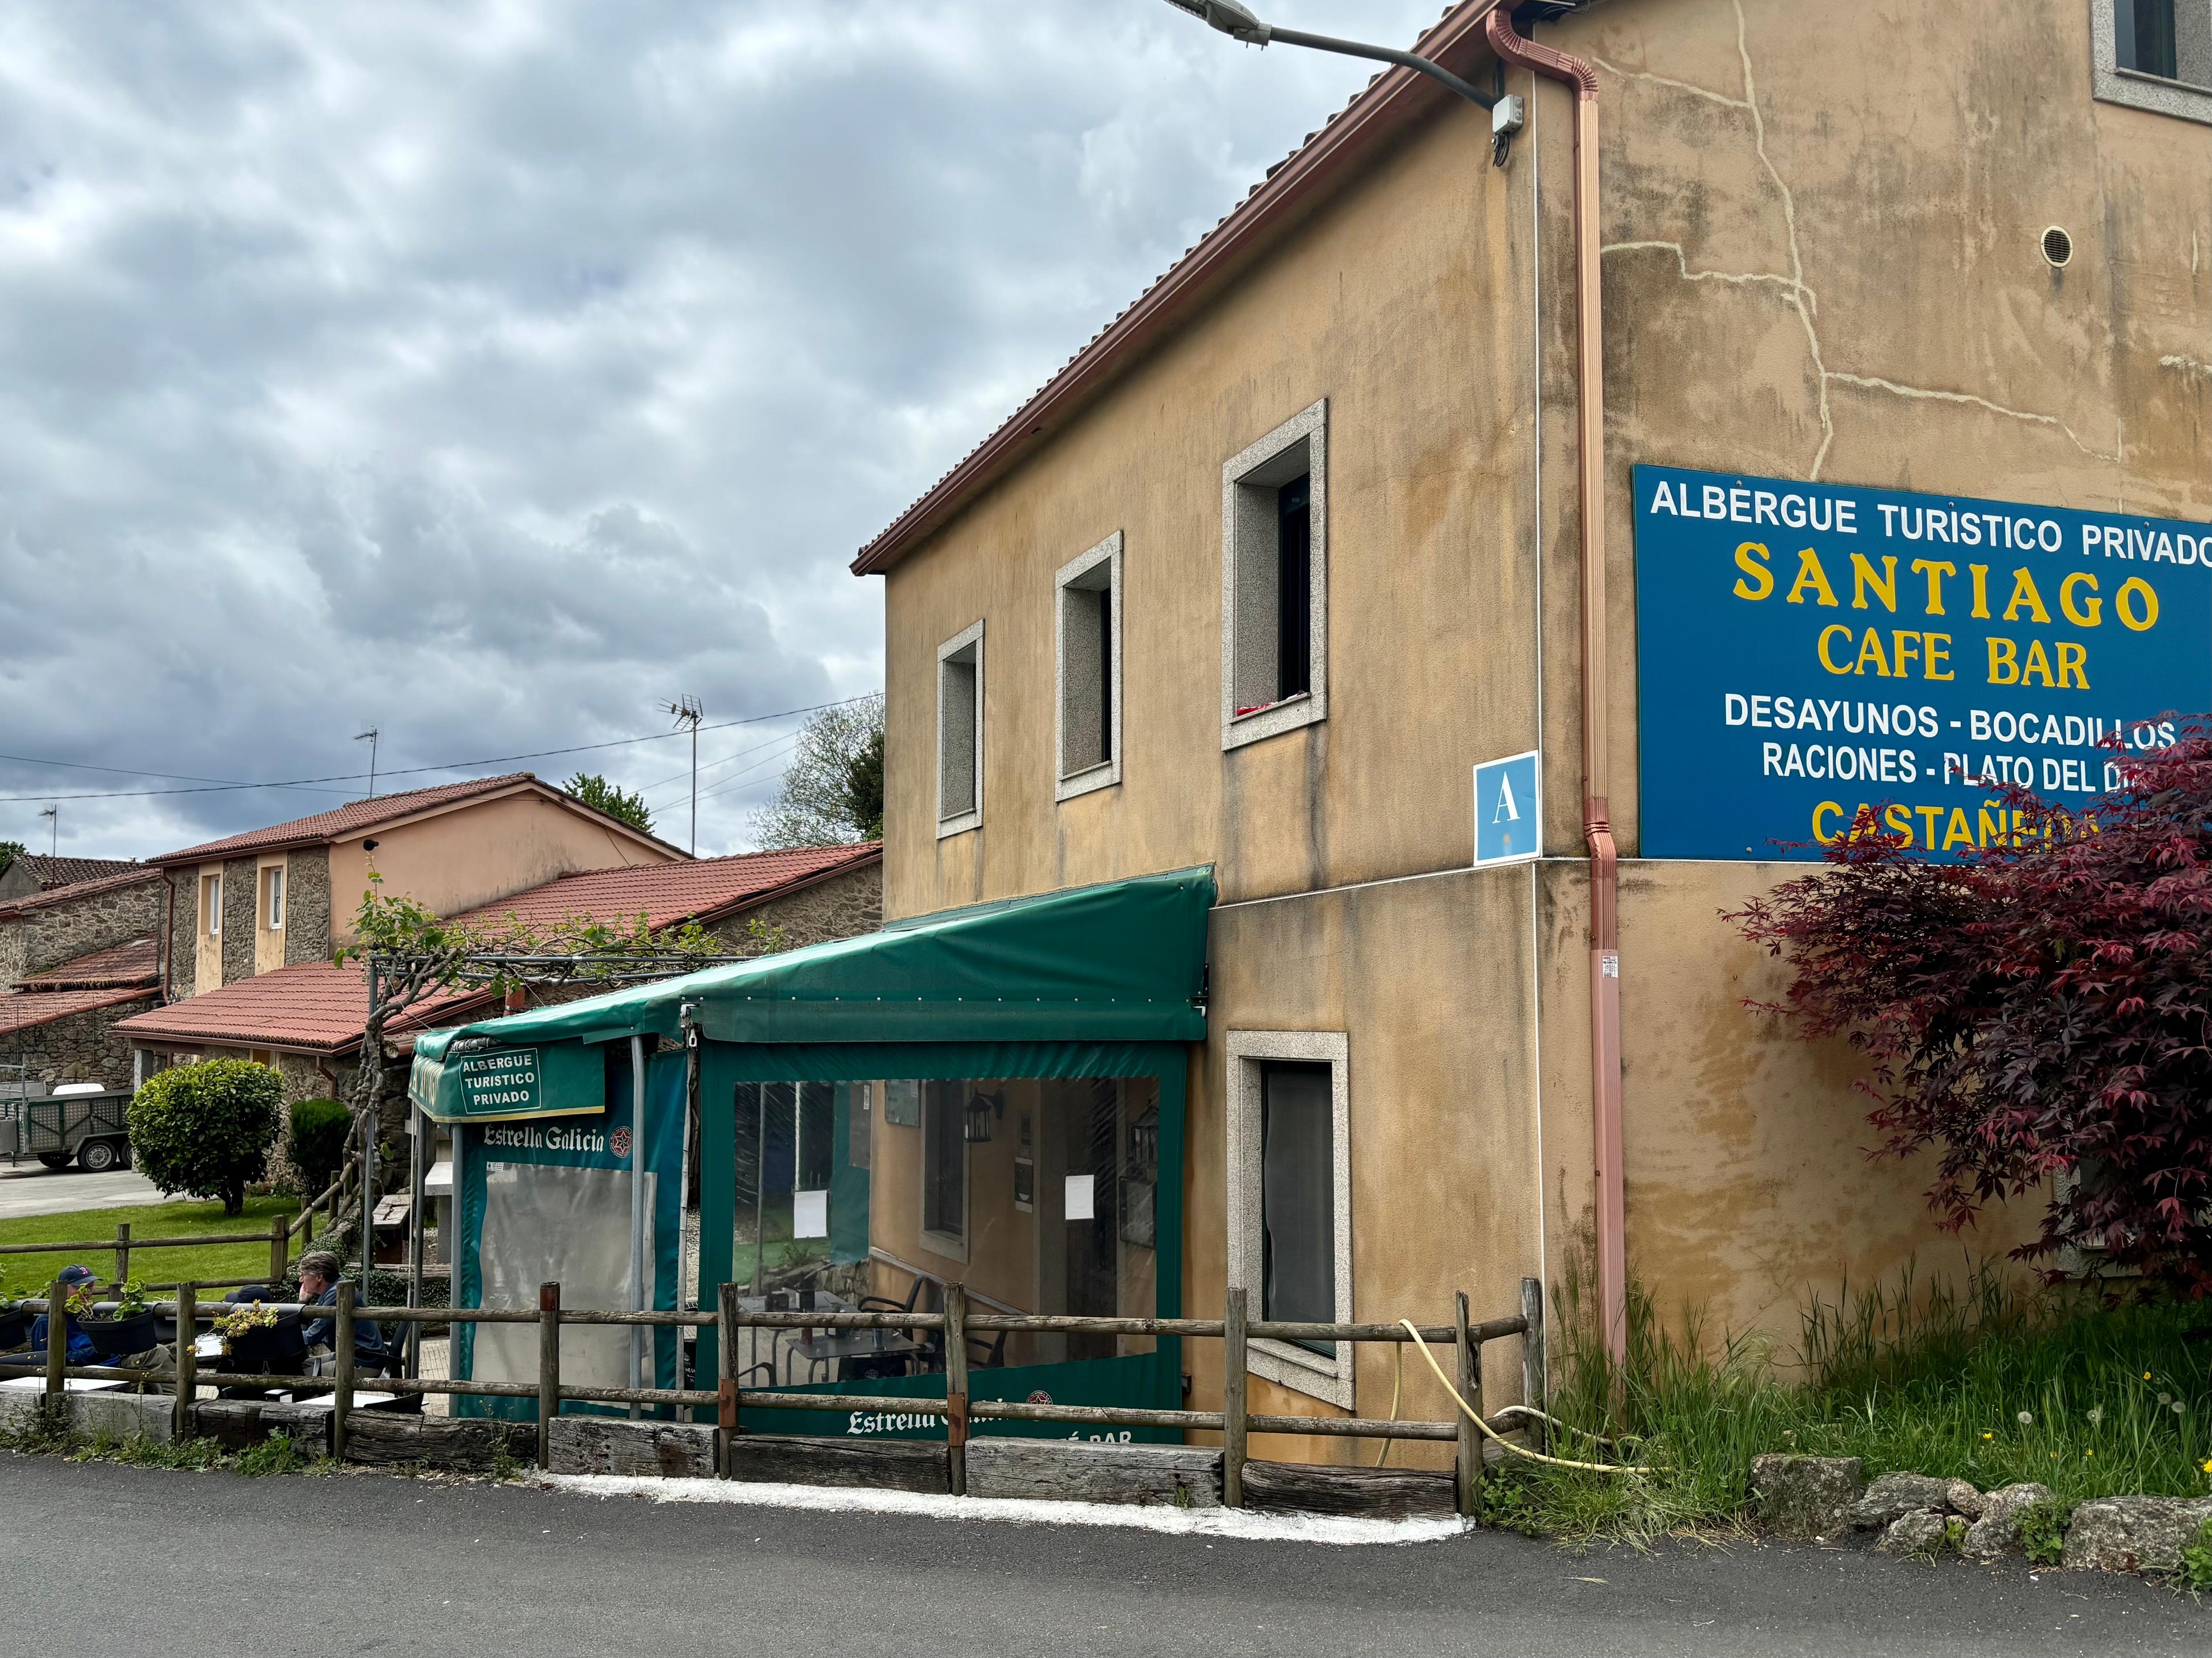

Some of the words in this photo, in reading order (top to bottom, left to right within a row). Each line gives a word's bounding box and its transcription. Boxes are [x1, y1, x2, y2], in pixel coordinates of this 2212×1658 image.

[1650, 480, 1858, 534] ALBERGUE
[1877, 503, 2063, 553] TURISTICO
[2082, 523, 2212, 568] PRIVADO
[1733, 541, 2160, 632] SANTIAGO
[1817, 624, 1955, 682] CAFE
[1986, 637, 2090, 690] BAR
[1725, 693, 1939, 738] DESAYUNOS
[1969, 709, 2176, 751] BOCADILLOS
[1763, 741, 1917, 784] RACIONES
[1943, 752, 2035, 790] PLATO
[2042, 757, 2096, 792] DEL
[1491, 771, 1521, 824] A
[463, 1054, 532, 1072] ALBERGUE
[464, 1072, 535, 1089] TURISTICO
[473, 1090, 530, 1106] PRIVADO
[483, 1123, 543, 1149] Estrella
[546, 1126, 605, 1152] Galicia
